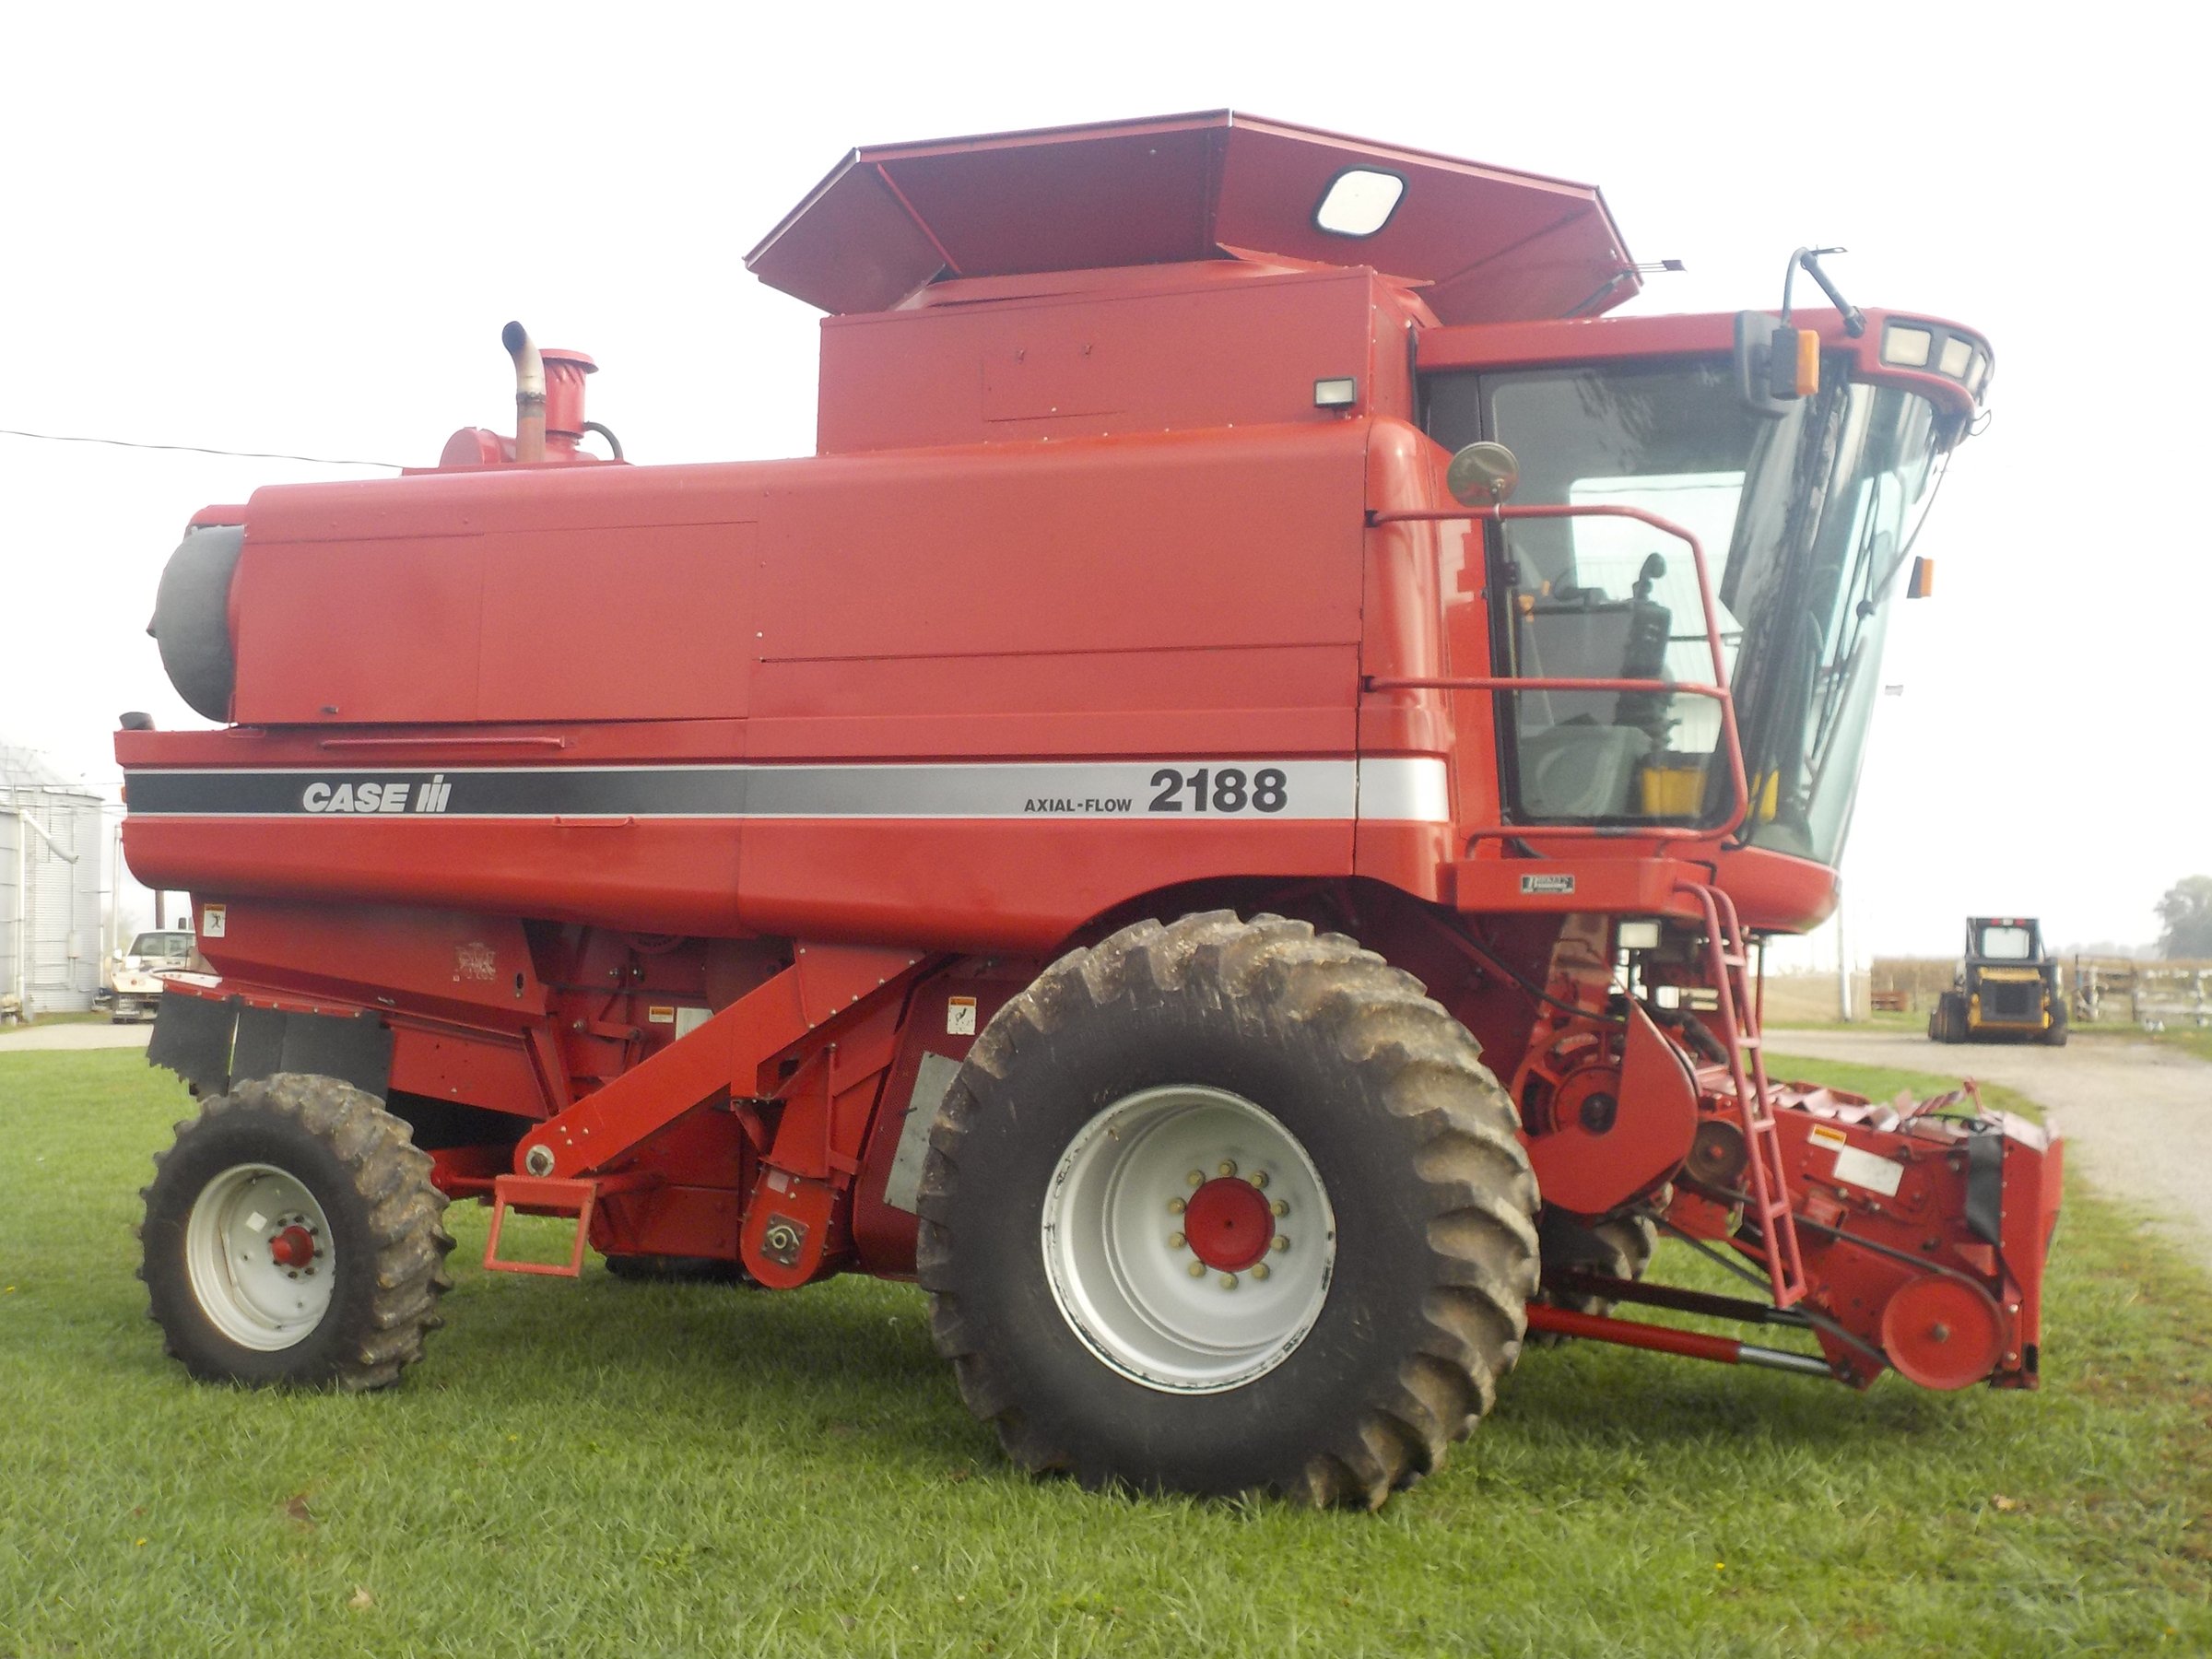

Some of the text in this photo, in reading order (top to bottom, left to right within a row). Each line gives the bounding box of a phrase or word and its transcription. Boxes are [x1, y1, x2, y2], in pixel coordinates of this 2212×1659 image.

[303, 782, 410, 812] CASE
[1024, 768, 1288, 813] AXIAL-FLOW 2188
